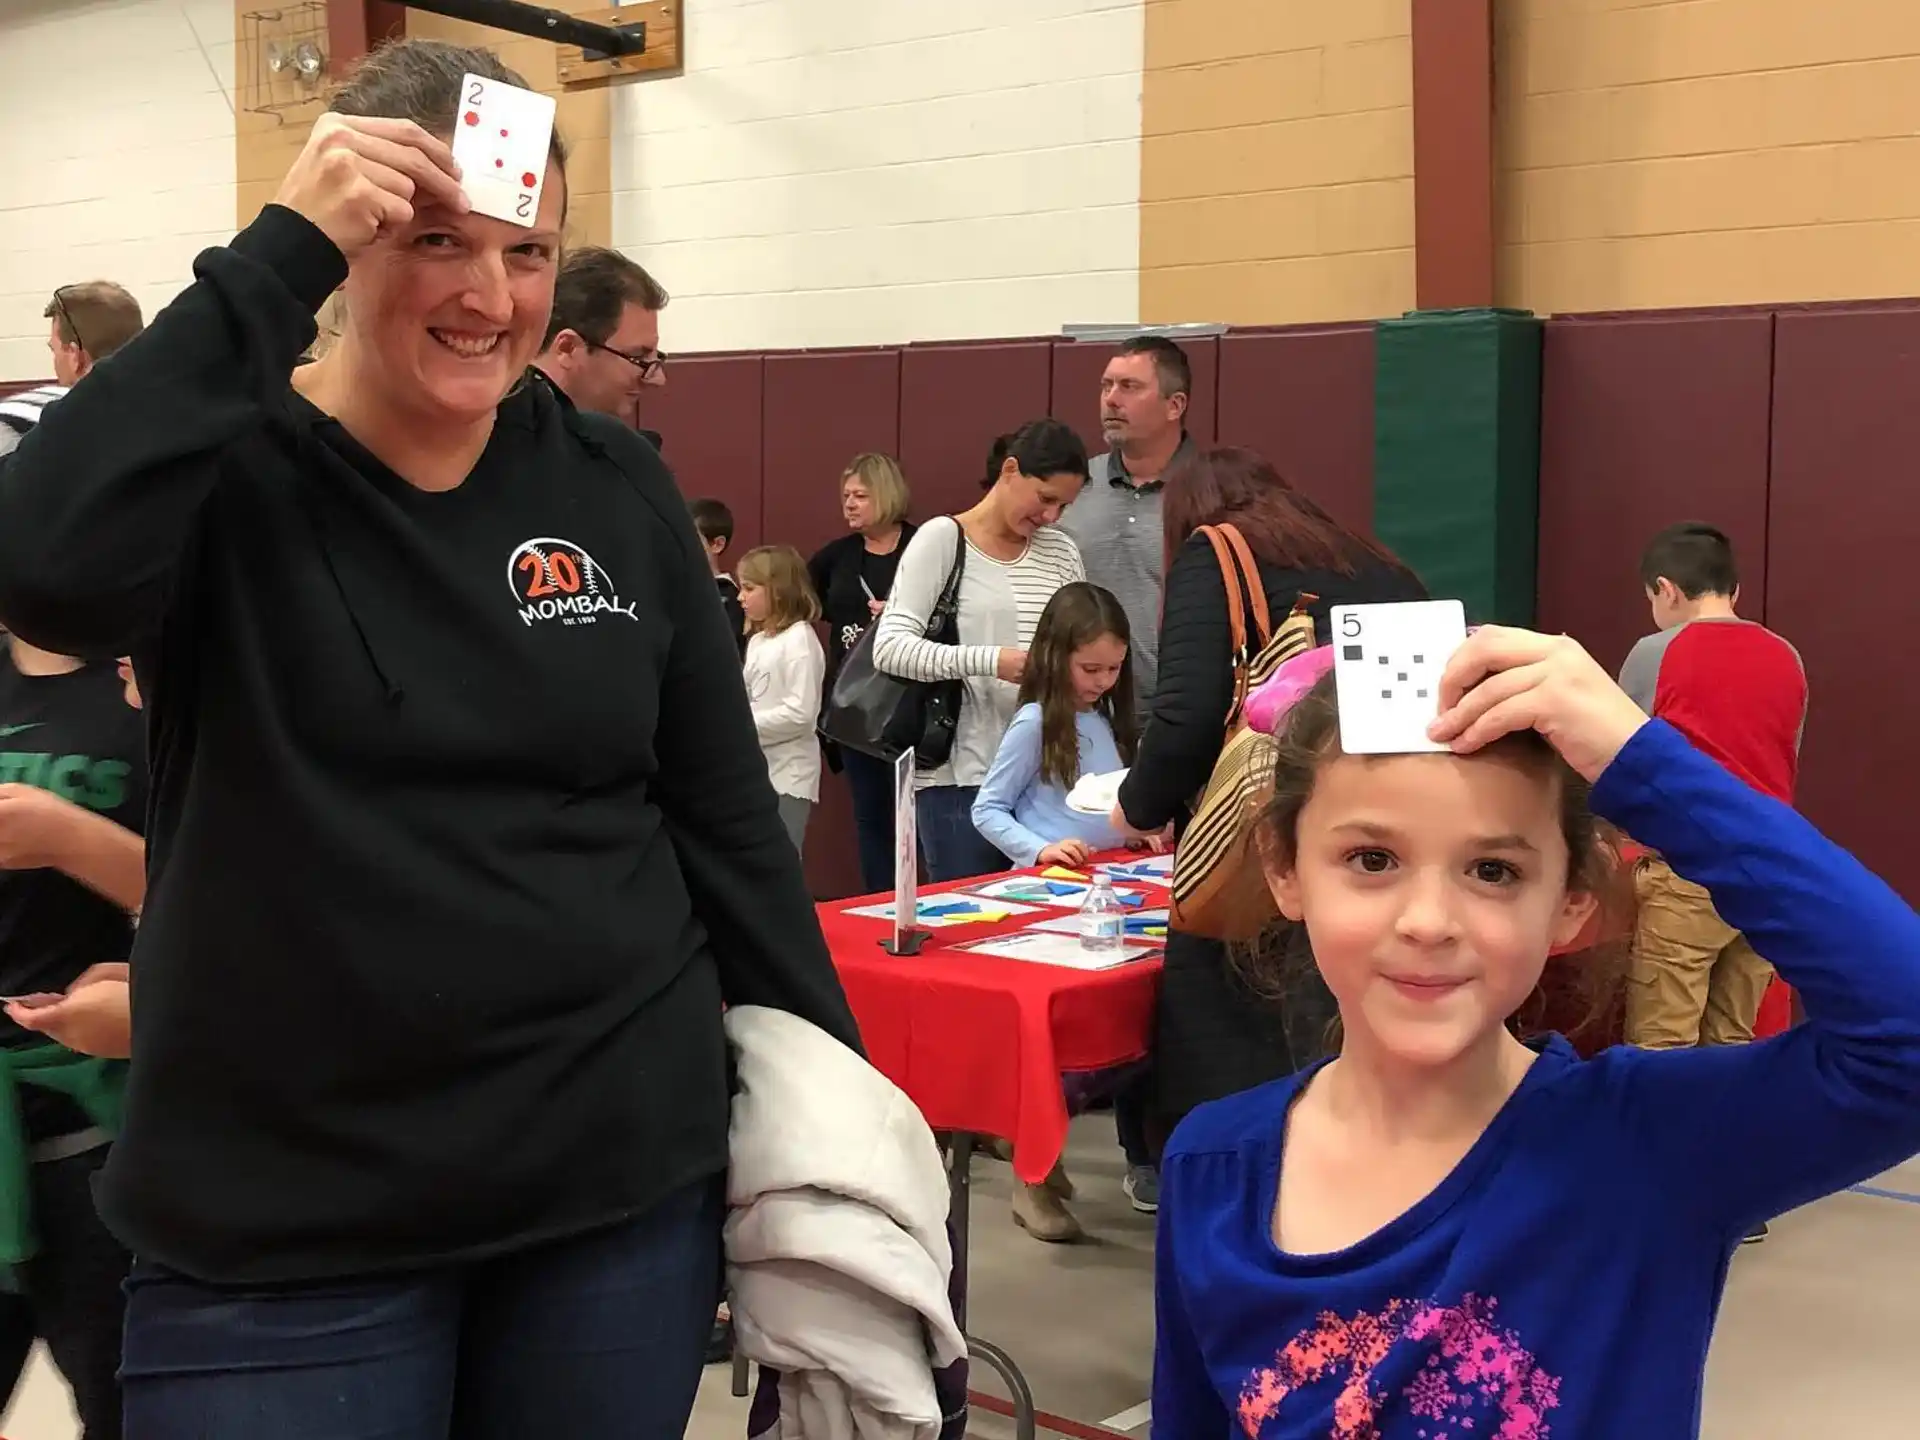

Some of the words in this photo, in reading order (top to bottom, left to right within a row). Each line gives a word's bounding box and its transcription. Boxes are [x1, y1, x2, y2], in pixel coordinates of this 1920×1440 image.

[468, 82, 484, 106] 2
[516, 193, 532, 218] 2
[518, 595, 639, 627] MOMBALL
[1342, 613, 1362, 637] 5
